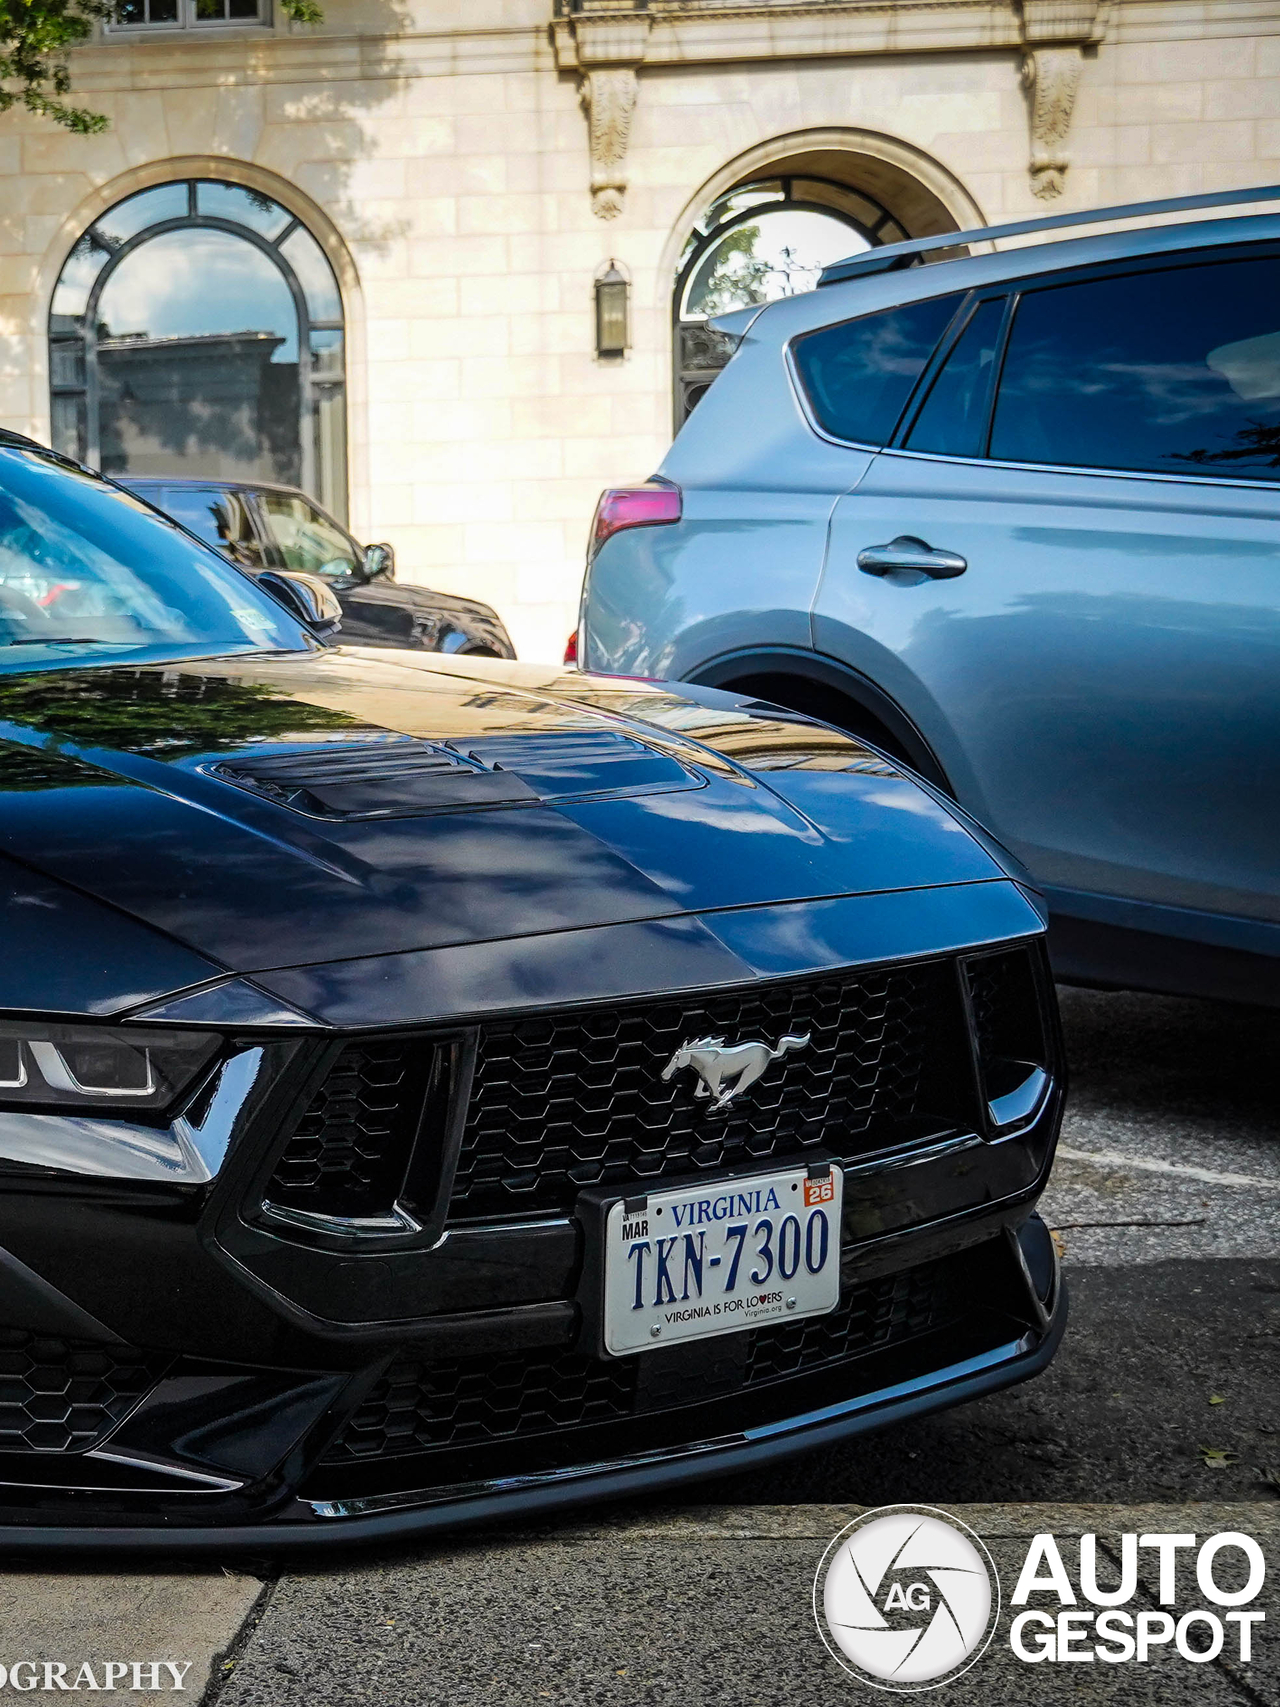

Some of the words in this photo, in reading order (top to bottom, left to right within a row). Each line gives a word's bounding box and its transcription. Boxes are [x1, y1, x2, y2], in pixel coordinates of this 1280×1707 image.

[809, 1184, 832, 1203] 26
[671, 1187, 781, 1228] VIRGINIA
[622, 1220, 648, 1241] MAR
[627, 1208, 829, 1310] TKN-7300
[664, 1305, 712, 1324] VIRGINIA
[713, 1303, 721, 1315] IS
[723, 1299, 745, 1313] FOR
[744, 1305, 782, 1318] Virginia.org
